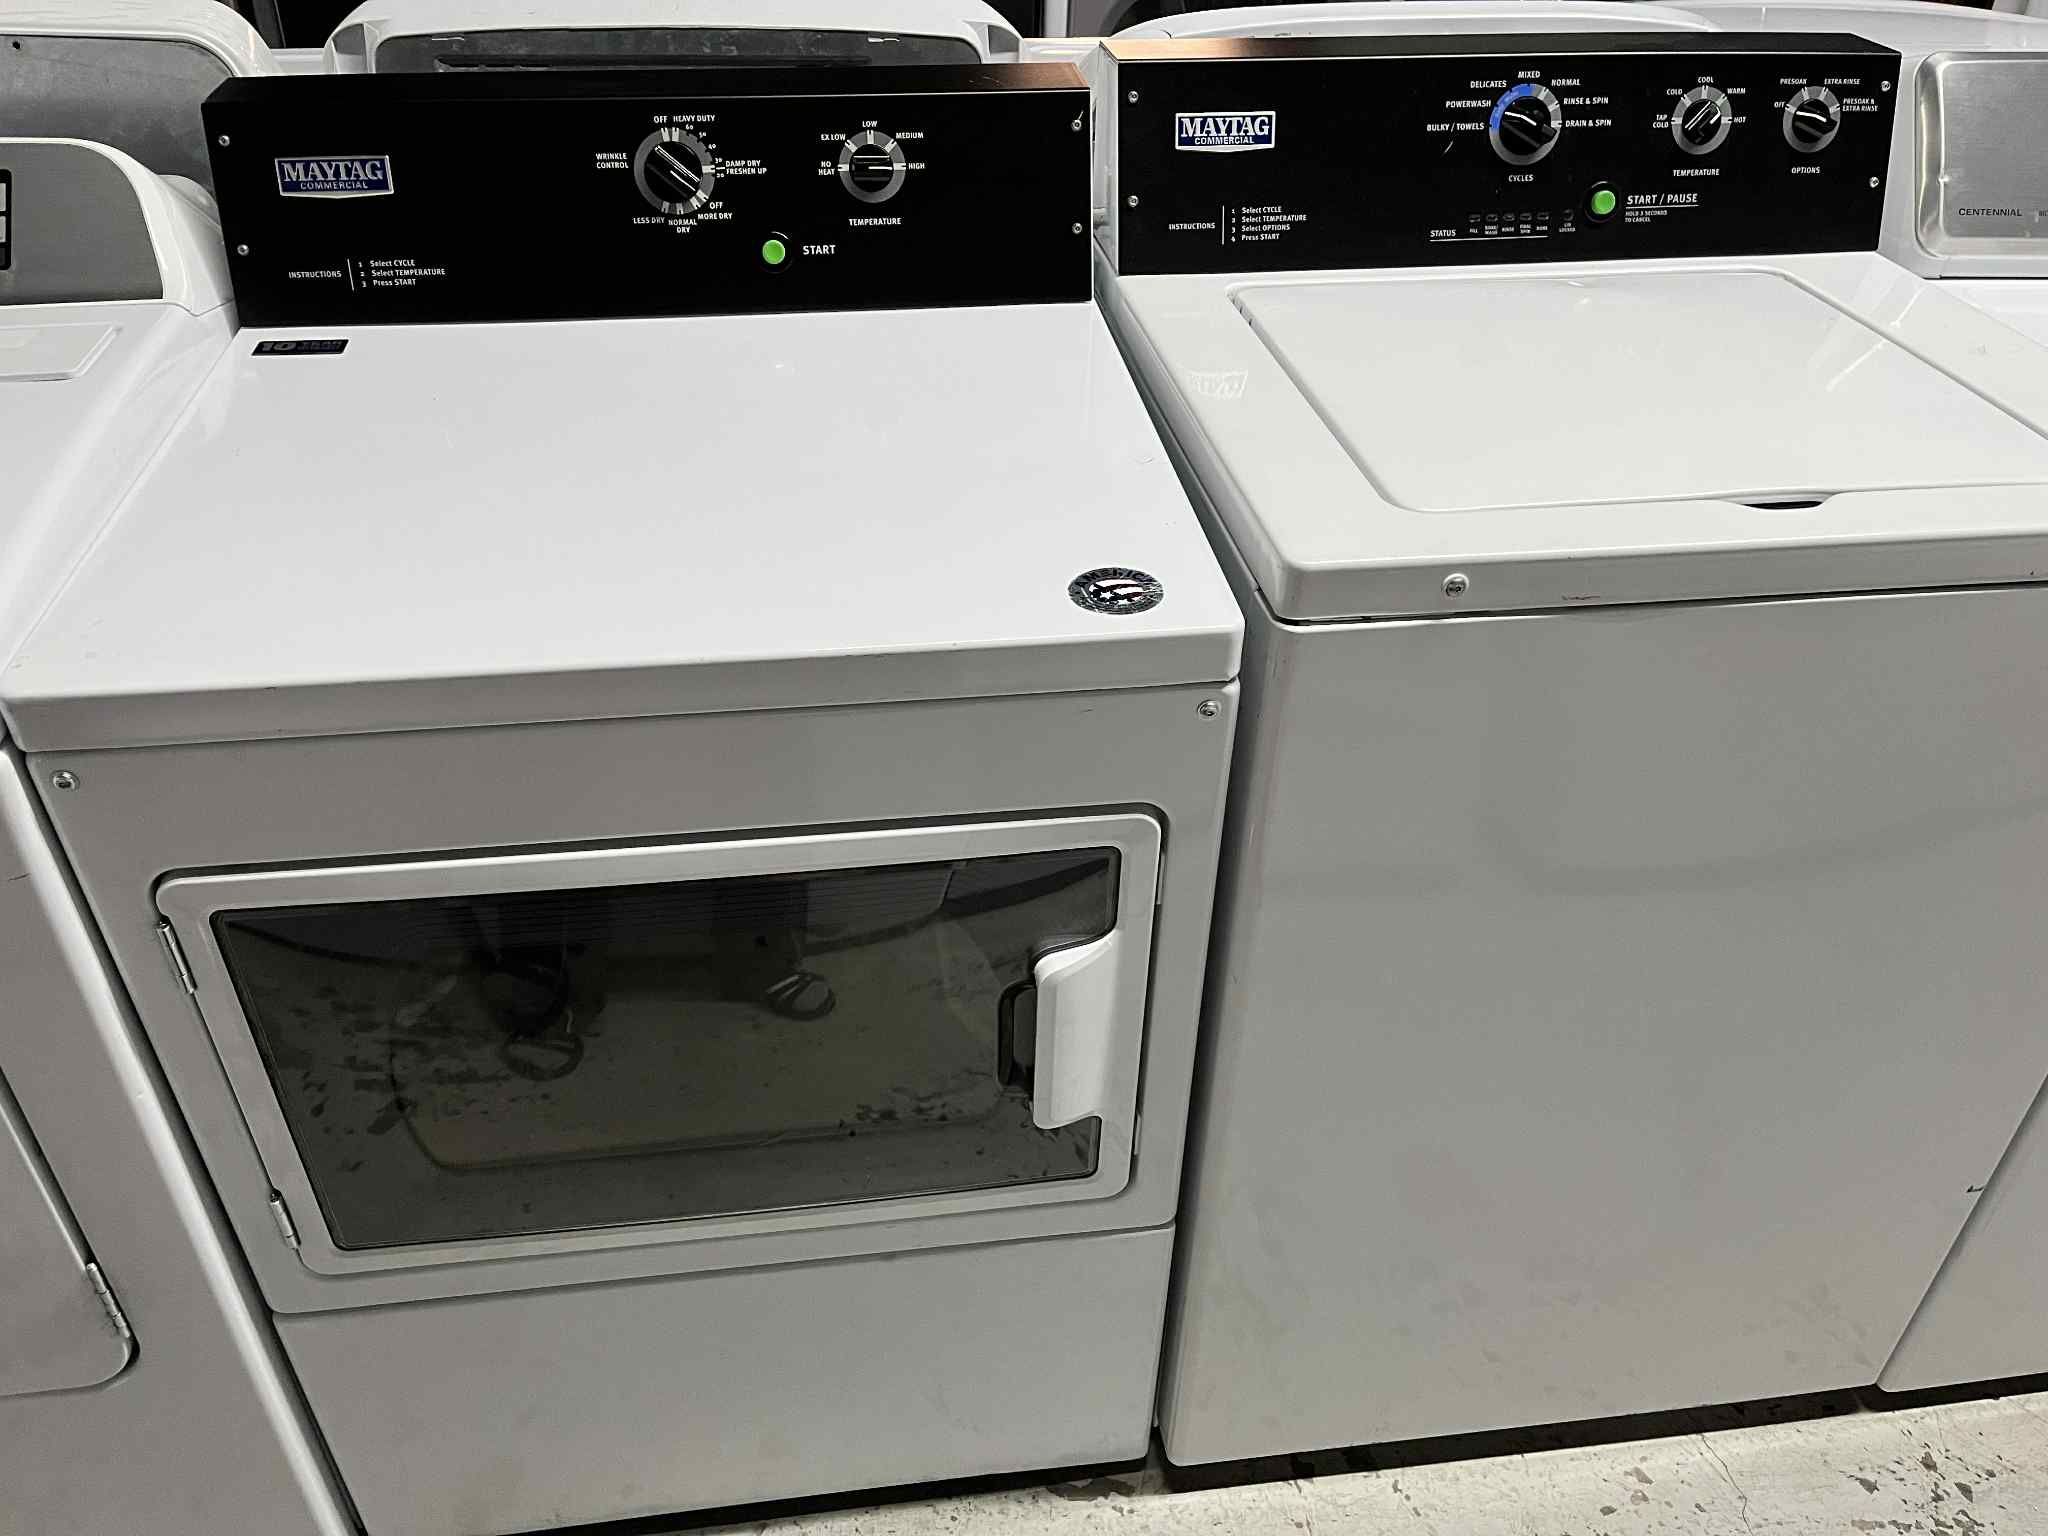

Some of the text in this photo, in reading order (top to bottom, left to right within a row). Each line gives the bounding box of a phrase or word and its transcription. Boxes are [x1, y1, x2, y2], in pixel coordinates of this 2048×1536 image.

[1518, 71, 1540, 79] MIXED
[1470, 80, 1507, 89] DELICATES
[1446, 100, 1491, 108] POWERWASH
[1563, 97, 1584, 105] RINSE
[1592, 97, 1608, 105] SPIN
[1180, 116, 1269, 137] MAYTAG
[1427, 122, 1485, 132] BULKY / TOWELS
[1588, 119, 1593, 127] &
[1595, 119, 1612, 127] SPIN
[821, 133, 846, 141] EX LOW
[1194, 136, 1255, 145] COMMERCIAL
[908, 162, 925, 170] HIGH
[281, 160, 383, 181] MAYTAG
[818, 168, 835, 176] HEAT
[1673, 168, 1720, 176] TEMPERATURE
[1508, 174, 1534, 182] CYCLES
[300, 181, 368, 190] COMMERCIAL
[1627, 193, 1698, 205] START / PAUSE
[1242, 206, 1262, 214] Select
[1959, 208, 2023, 216] CENTENNIAL
[849, 217, 901, 226] TEMPERATURE
[1242, 215, 1261, 223] Select
[1169, 222, 1215, 231] INSTRUCTIONS
[1242, 224, 1261, 232] Select
[803, 244, 836, 255] START
[393, 259, 416, 267] CYCLE
[371, 269, 394, 277] Select
[395, 268, 445, 276] TEMPERATURE
[394, 278, 416, 286] START
